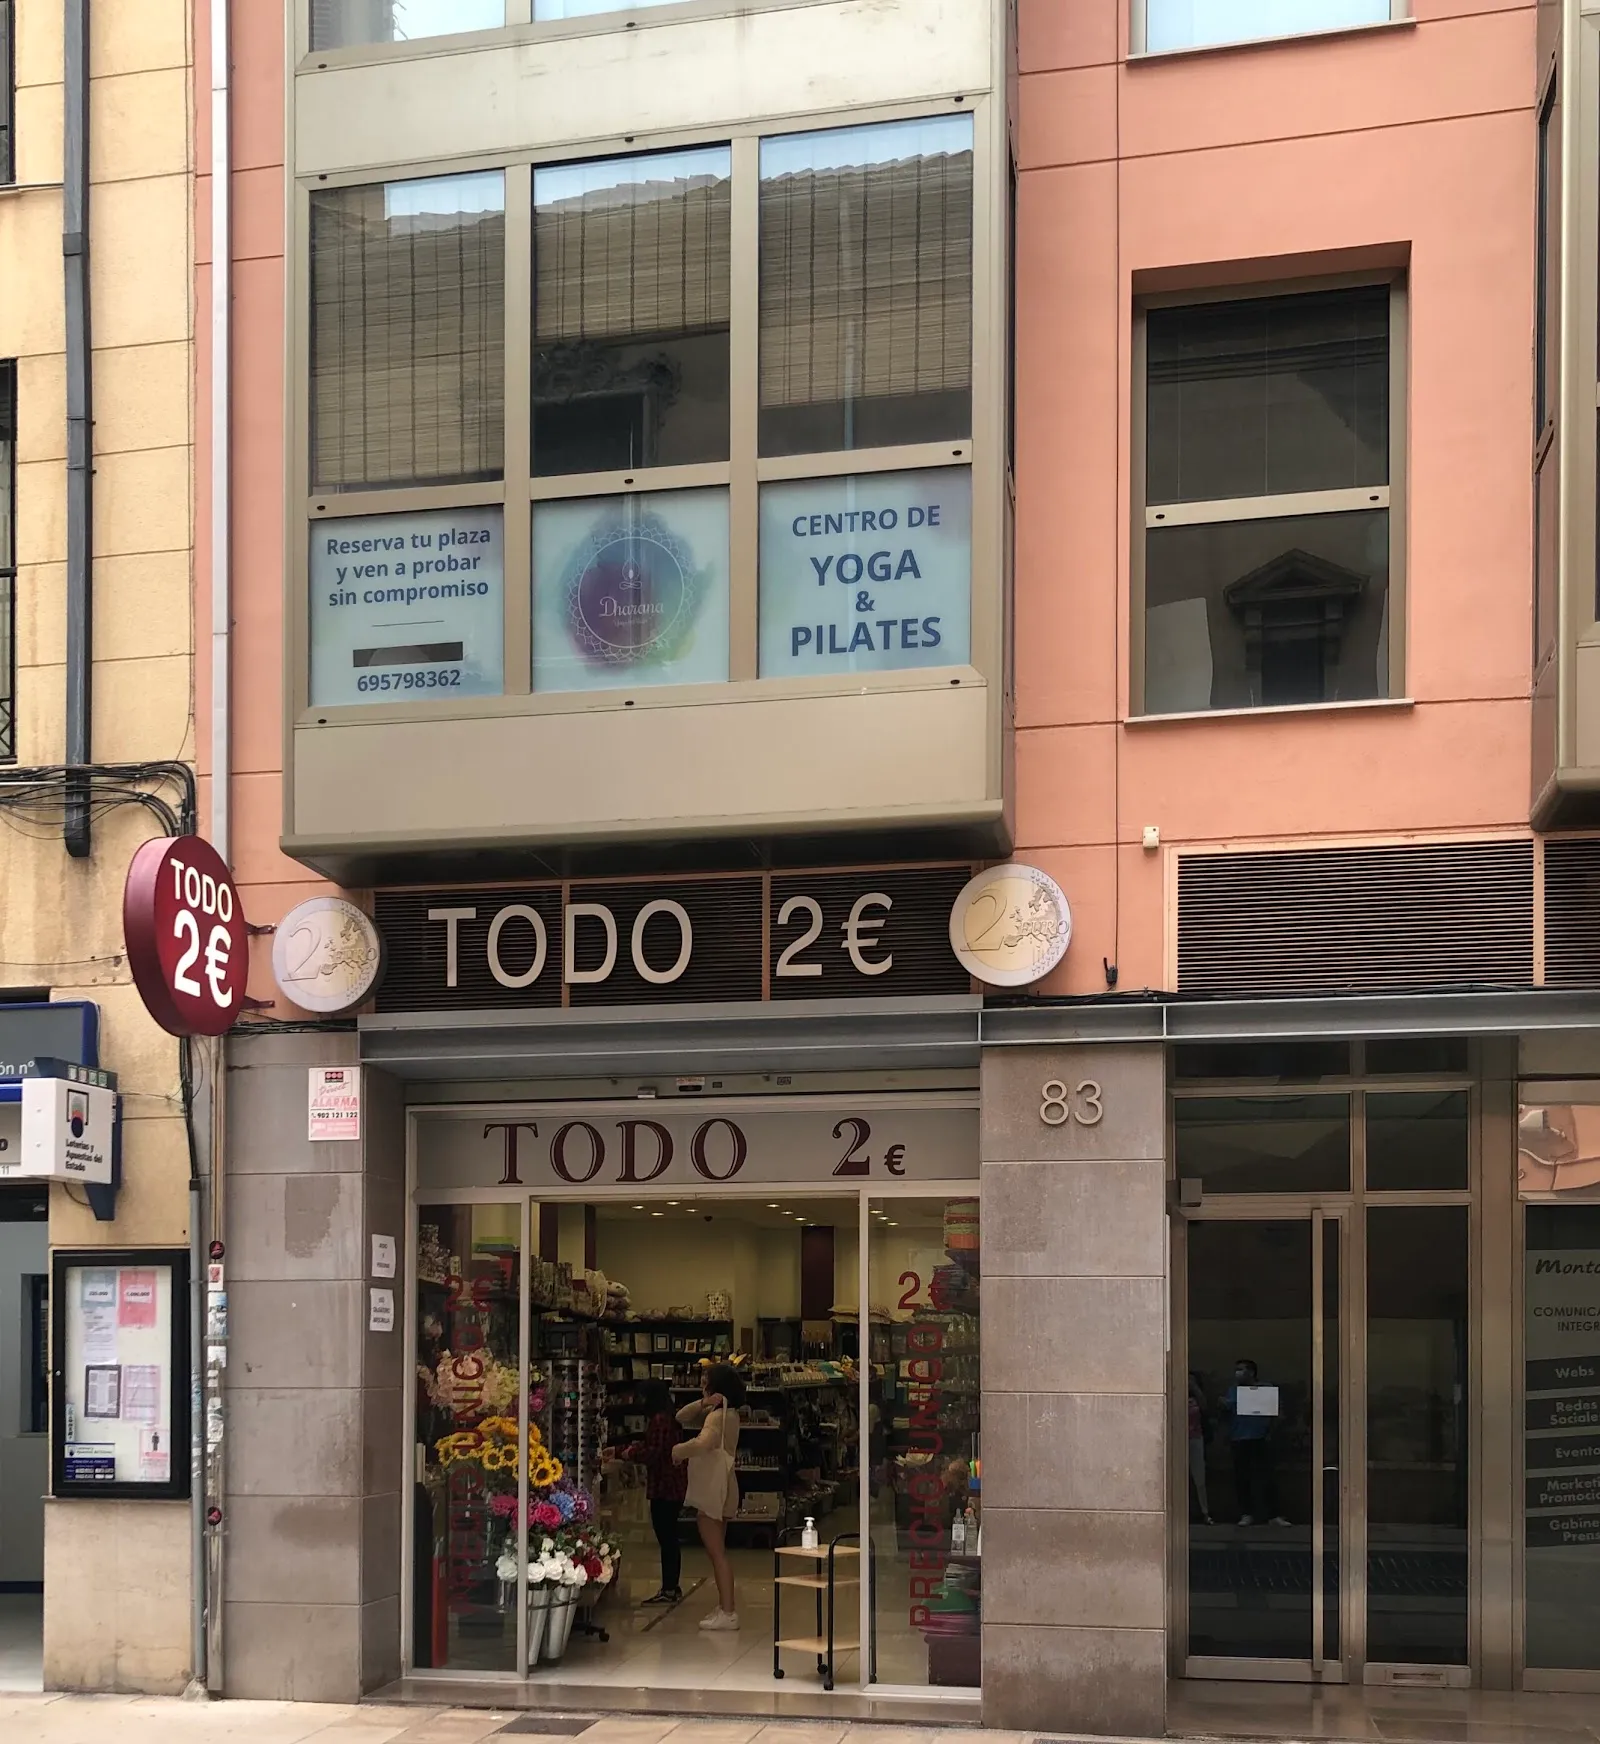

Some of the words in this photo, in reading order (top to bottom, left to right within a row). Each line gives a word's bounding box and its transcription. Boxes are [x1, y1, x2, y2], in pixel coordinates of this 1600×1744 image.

[792, 508, 898, 537] CENTRO
[907, 505, 941, 528] DE
[327, 537, 405, 556] Reserva
[411, 532, 432, 549] tu
[438, 528, 491, 552] plaza
[336, 566, 348, 585] y
[352, 563, 389, 579] ven
[394, 562, 406, 576] a
[412, 554, 481, 580] probar
[809, 549, 922, 587] YOGA
[329, 589, 357, 607] sin
[363, 580, 489, 606] compromiso
[599, 596, 664, 617] Dharana
[855, 590, 875, 612] &
[791, 616, 942, 657] PILATES
[357, 669, 461, 692] 695798362
[170, 857, 233, 923] TODO
[427, 898, 693, 989] TODO
[312, 1097, 358, 1108] ALARMA
[1039, 1078, 1104, 1126] 83
[483, 1117, 748, 1185] TODO
[65, 1160, 86, 1172] Estado
[1555, 1365, 1595, 1379] Webs
[1555, 1398, 1598, 1413] Redes
[907, 1466, 945, 1629] PRECIO
